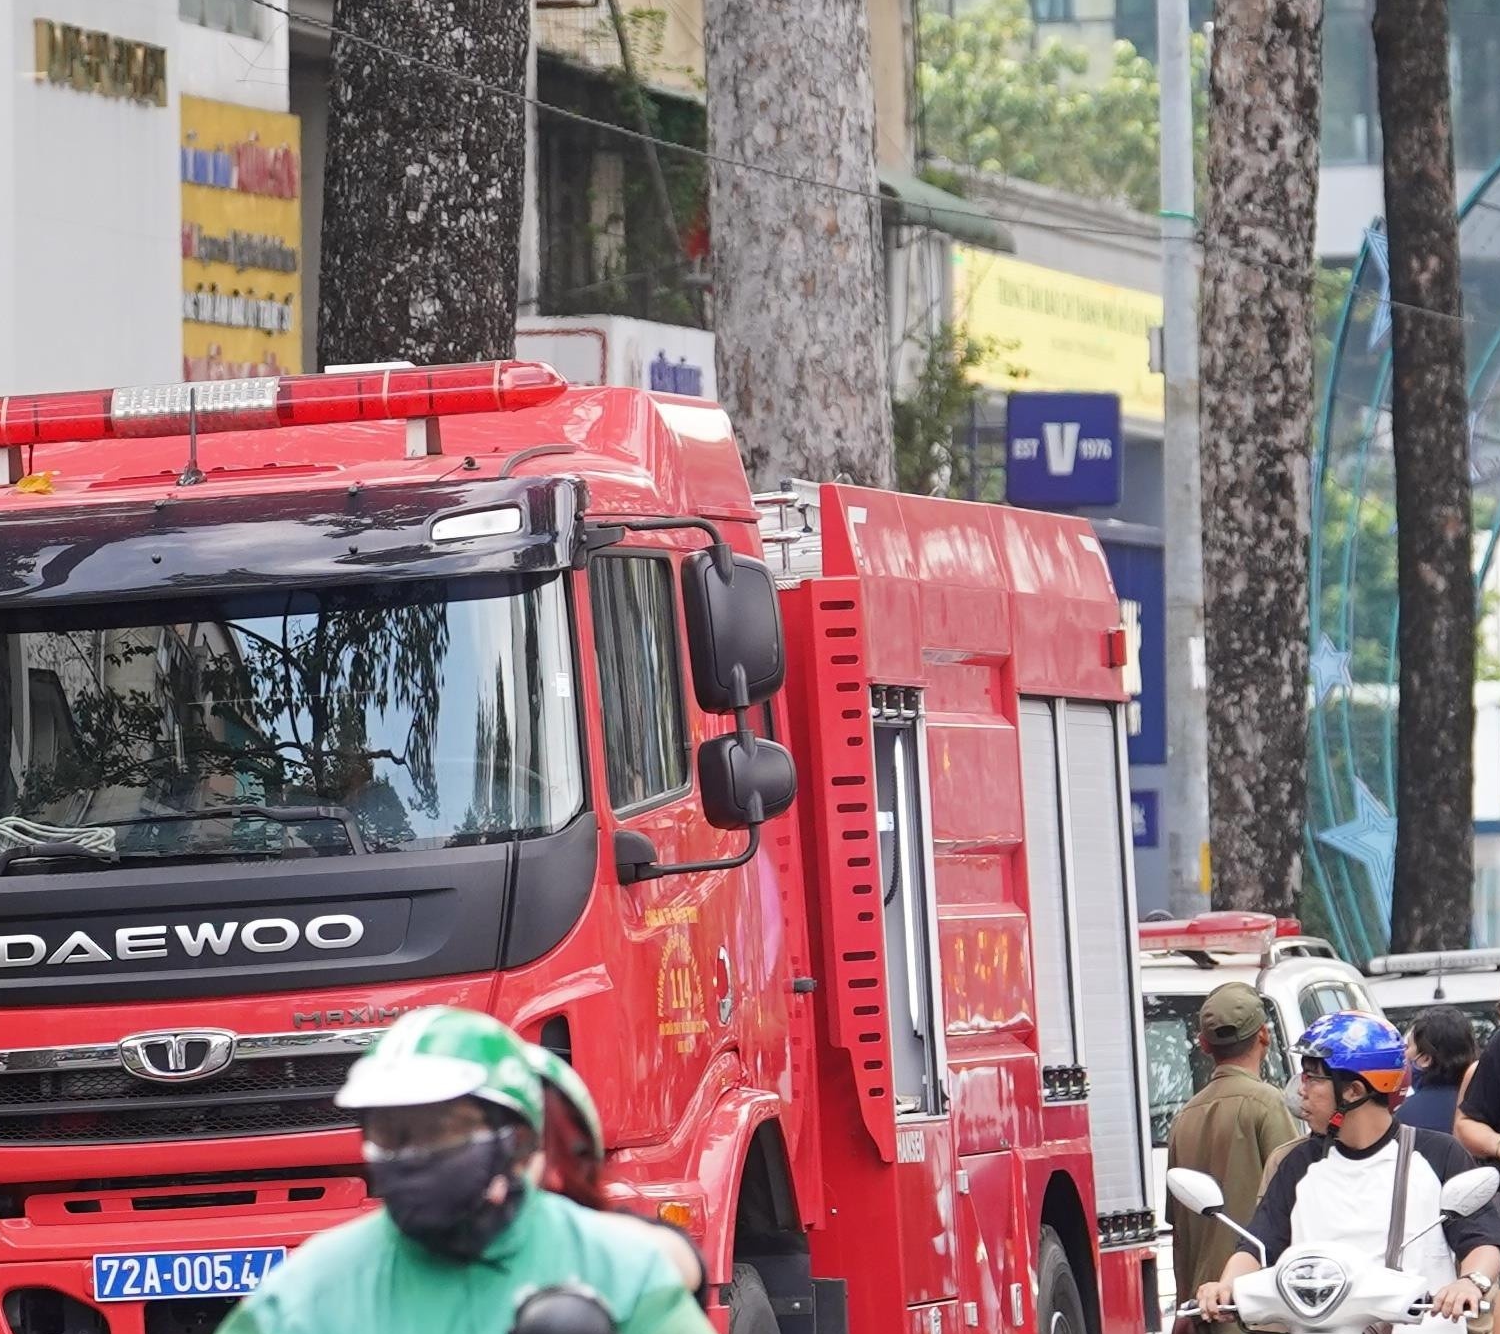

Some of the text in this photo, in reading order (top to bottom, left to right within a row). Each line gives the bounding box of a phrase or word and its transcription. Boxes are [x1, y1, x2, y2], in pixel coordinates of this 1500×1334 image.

[1042, 421, 1081, 476] V
[669, 966, 692, 1009] 114
[292, 1002, 422, 1030] MAXIM
